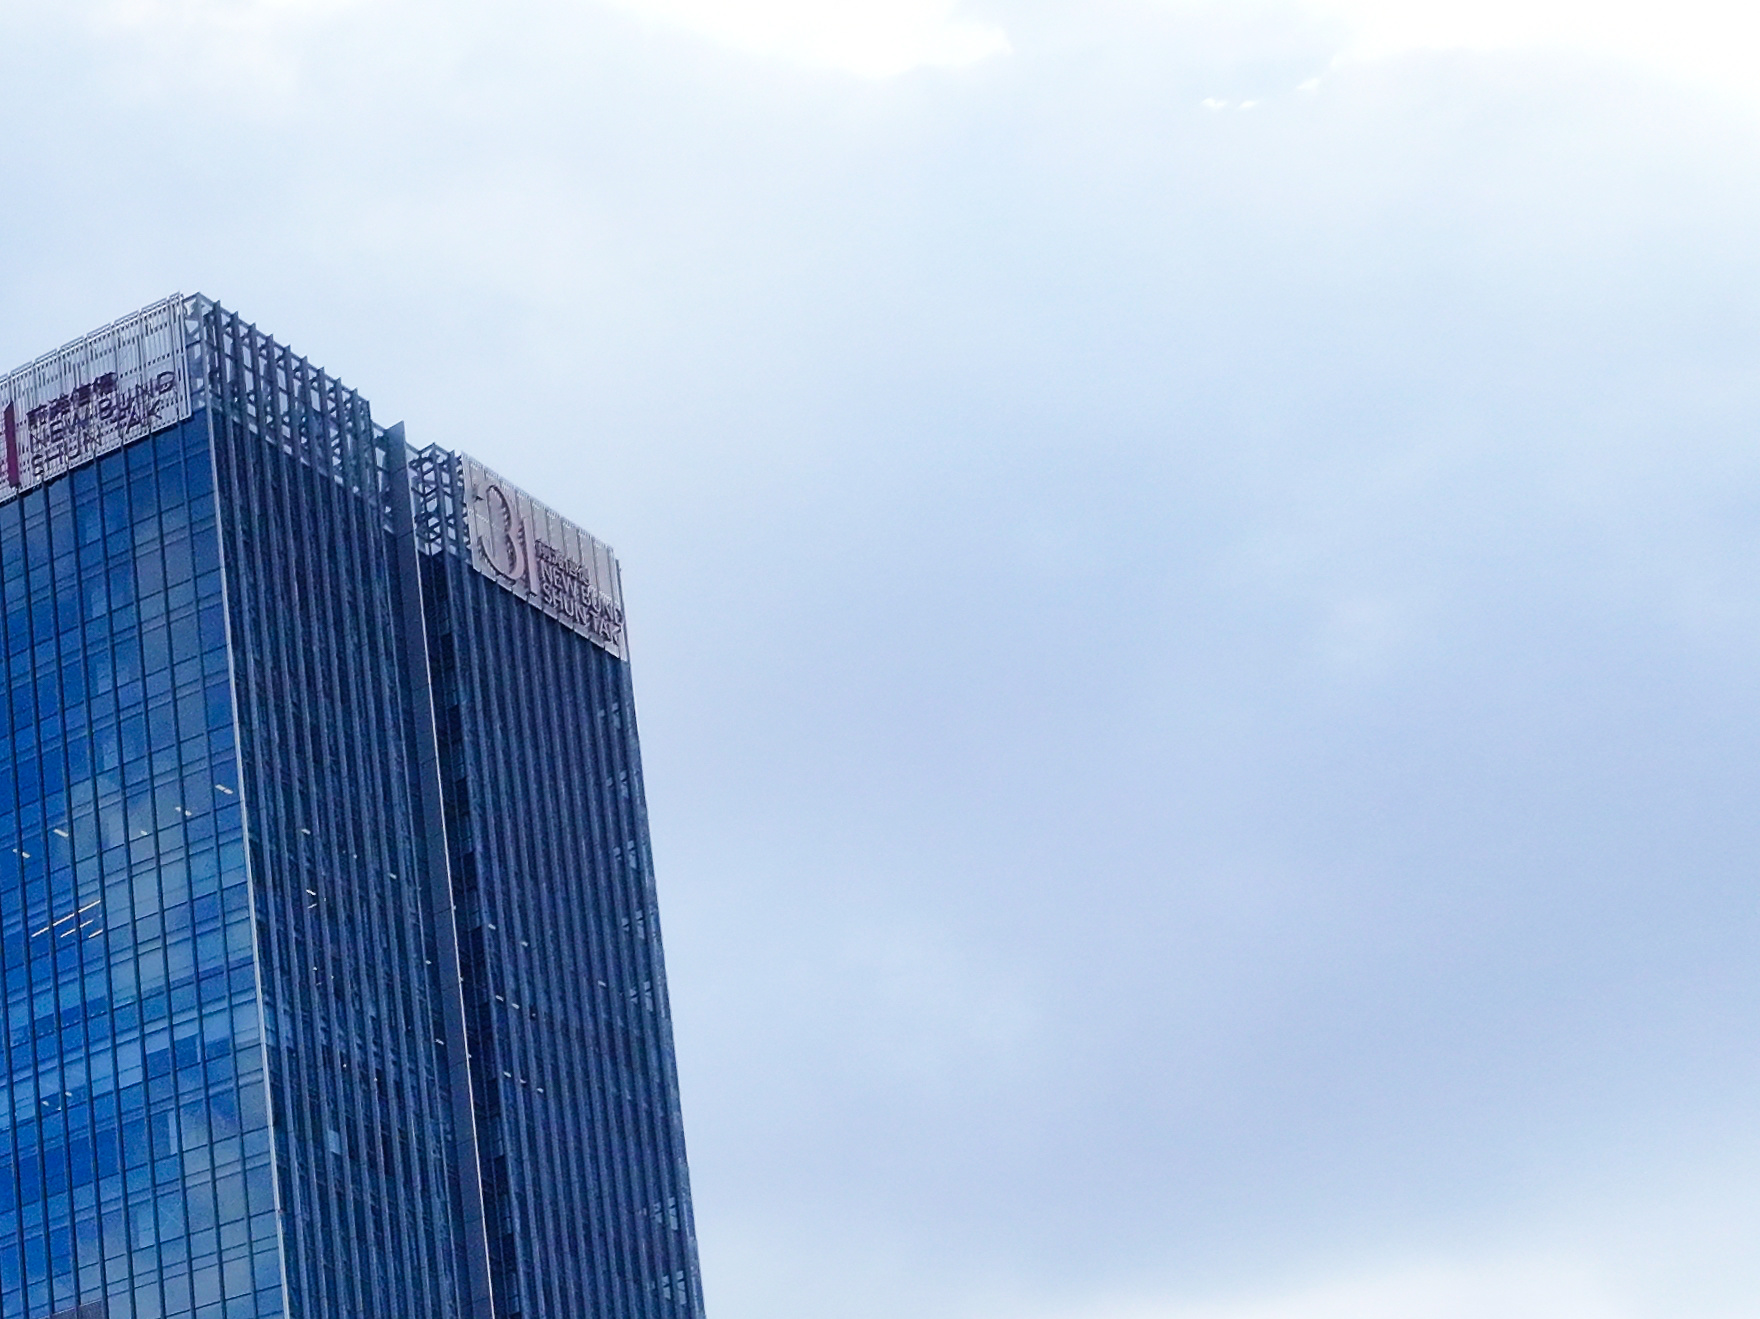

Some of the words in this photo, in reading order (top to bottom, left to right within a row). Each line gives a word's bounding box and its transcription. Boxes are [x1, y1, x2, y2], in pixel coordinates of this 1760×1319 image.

[29, 406, 94, 450] NEW
[98, 371, 176, 420] BUND
[541, 561, 579, 597] NEW
[581, 584, 625, 627] BUND
[542, 581, 589, 627] SHUN
[589, 609, 622, 647] TAK
